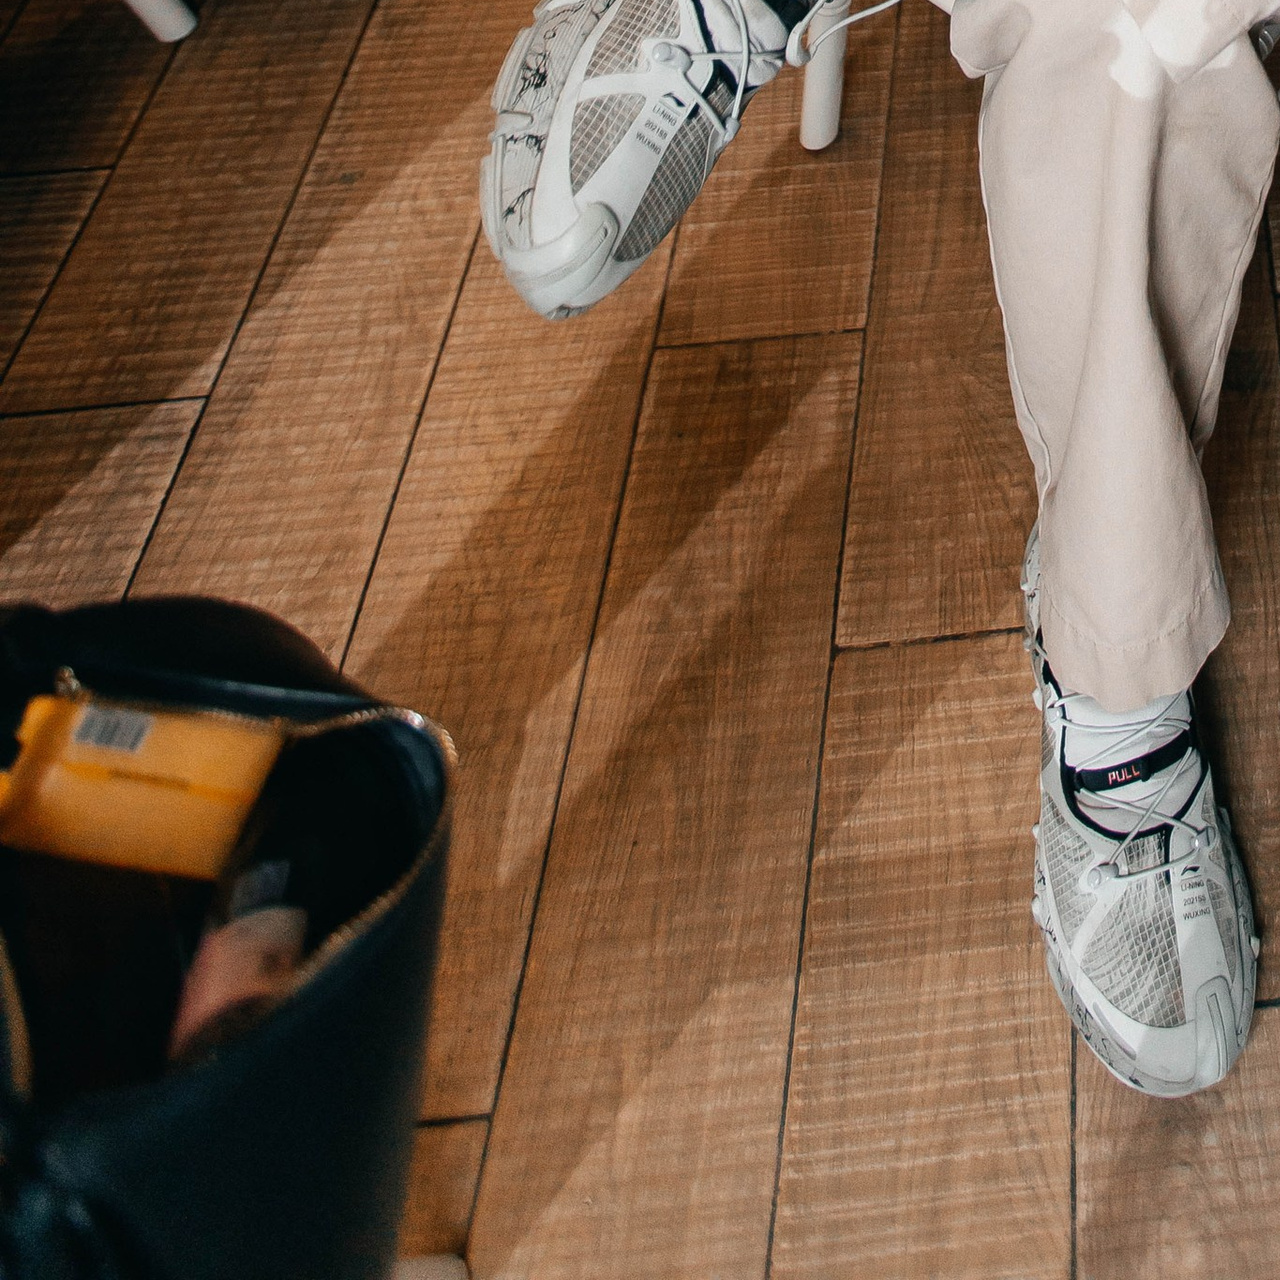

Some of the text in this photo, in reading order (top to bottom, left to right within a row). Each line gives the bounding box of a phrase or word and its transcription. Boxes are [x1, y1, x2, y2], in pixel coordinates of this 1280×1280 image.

[652, 104, 677, 127] LI-NING
[635, 131, 661, 155] WUXING
[1108, 765, 1140, 785] PULL
[1181, 880, 1205, 891] LI-NING
[1183, 907, 1211, 920] WUXING
